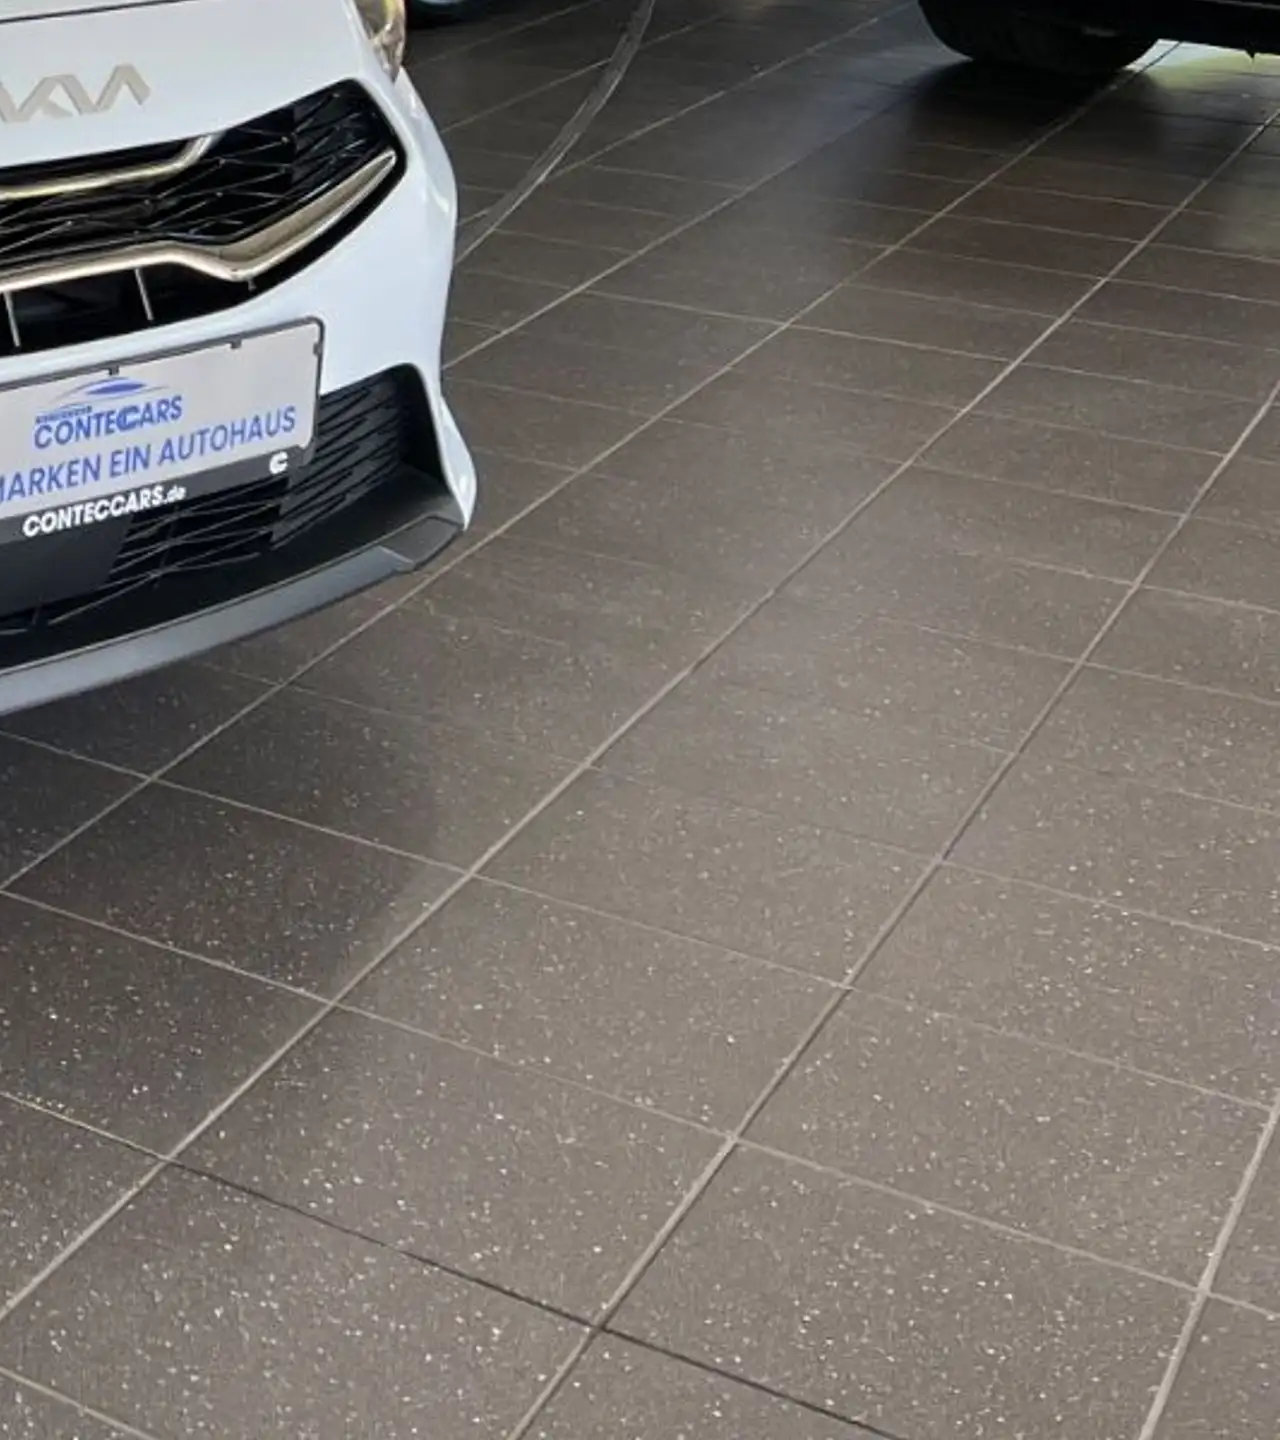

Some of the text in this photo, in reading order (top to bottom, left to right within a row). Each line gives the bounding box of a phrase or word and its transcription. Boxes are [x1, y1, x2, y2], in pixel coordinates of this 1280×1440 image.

[109, 444, 151, 478] EIN
[158, 406, 296, 466] AUTOHAUS
[23, 485, 187, 537] CONTECCARS.de
